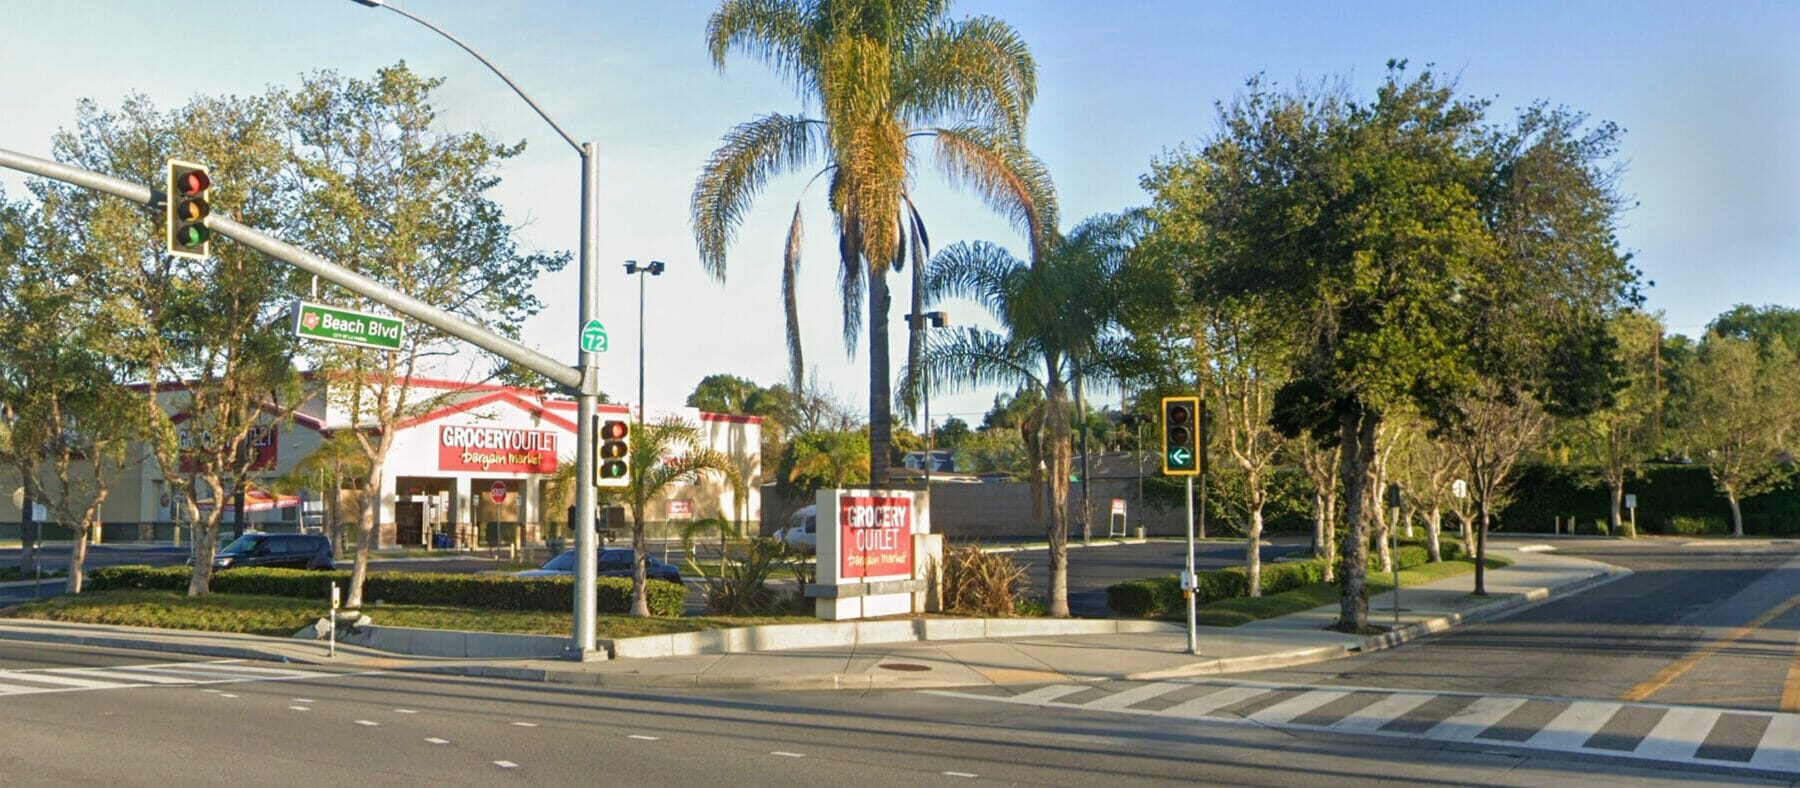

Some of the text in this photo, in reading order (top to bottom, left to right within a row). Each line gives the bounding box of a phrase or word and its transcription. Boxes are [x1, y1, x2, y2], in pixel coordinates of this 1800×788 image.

[322, 313, 399, 339] Beach Blvd
[585, 334, 604, 350] 72
[461, 446, 543, 470] bargain market
[491, 488, 506, 497] STOP
[847, 505, 906, 528] GROCERY
[856, 528, 899, 551] OUTLET
